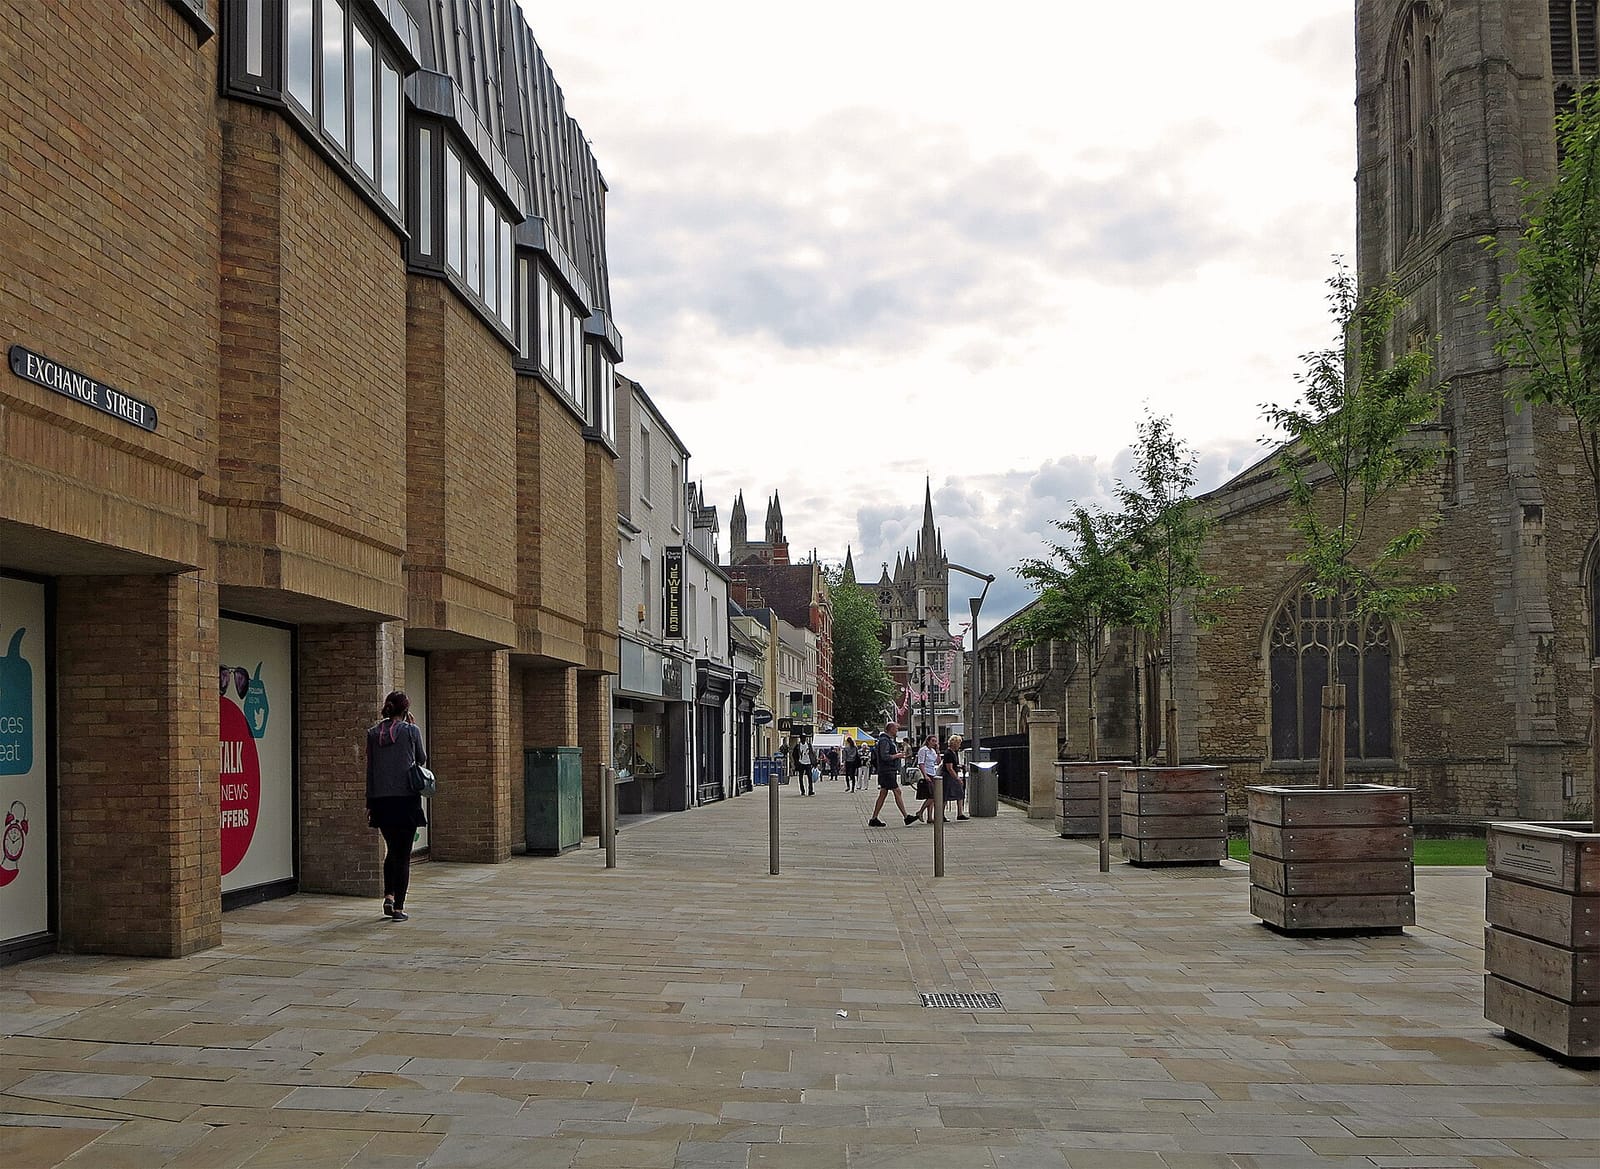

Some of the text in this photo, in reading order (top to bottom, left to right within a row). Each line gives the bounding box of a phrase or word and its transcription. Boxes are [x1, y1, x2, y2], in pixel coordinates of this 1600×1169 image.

[27, 353, 146, 425] EXCHANGE STREET
[668, 563, 681, 632] JEWELLERS
[221, 783, 249, 801] NEWS
[220, 808, 249, 829] FFERS
